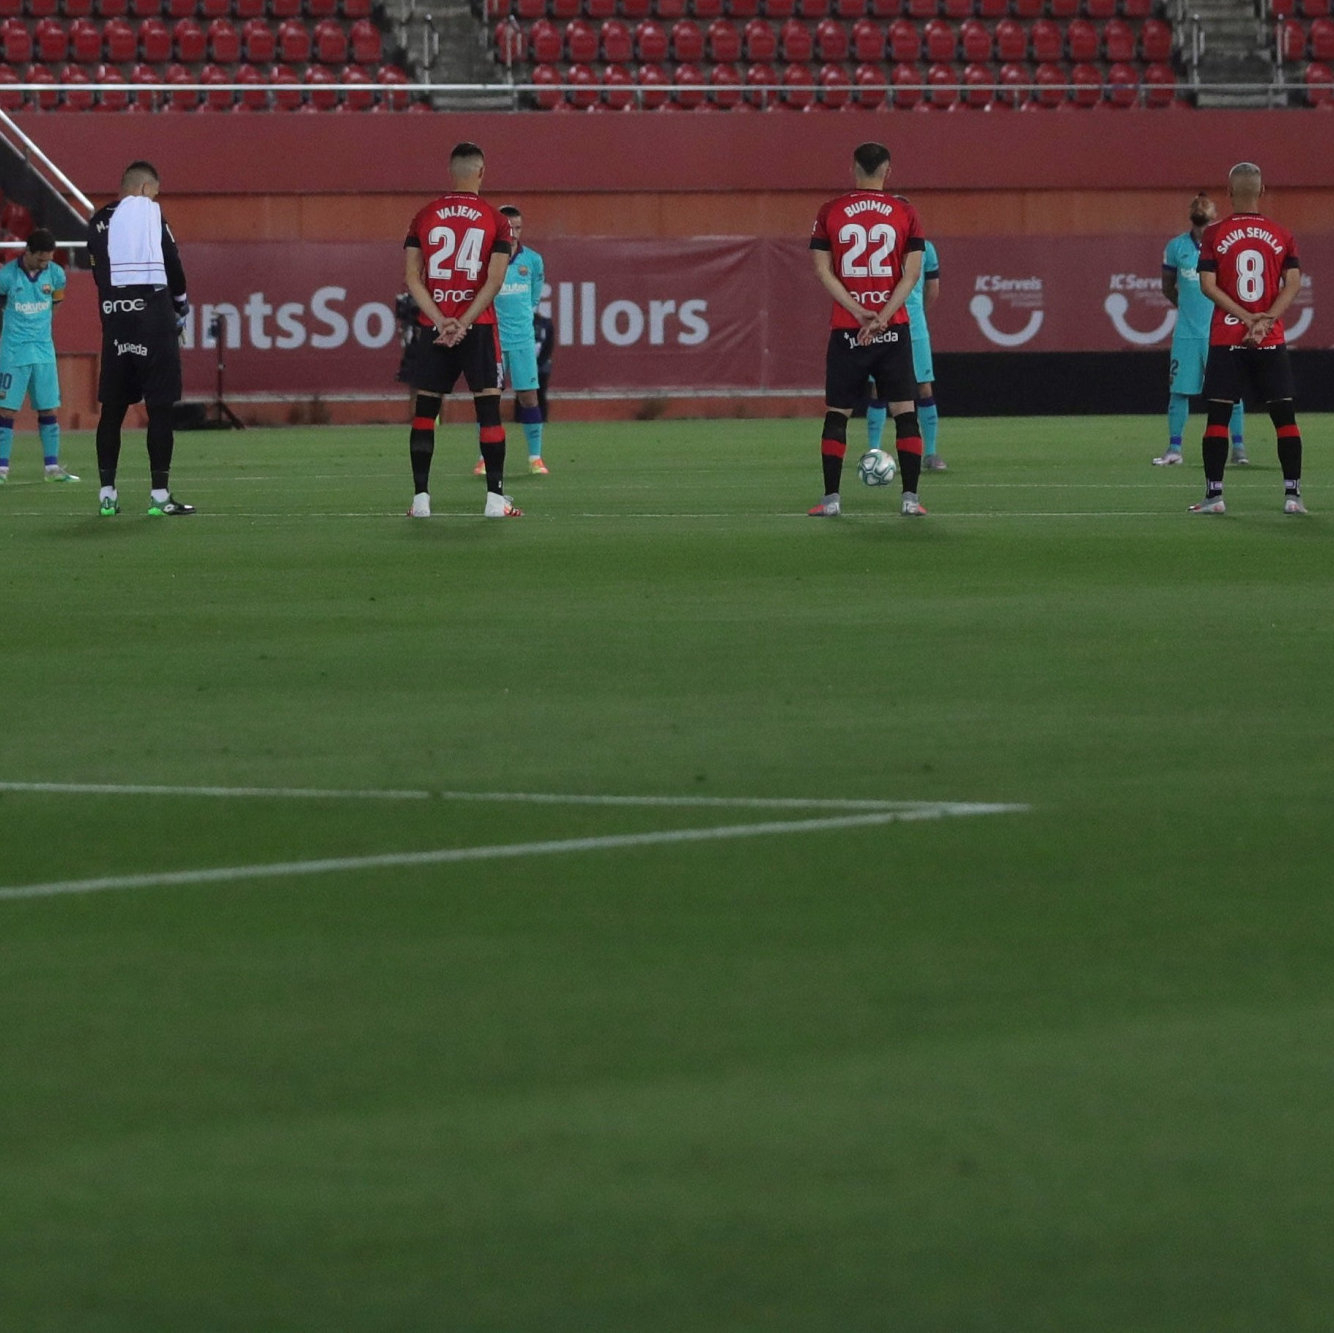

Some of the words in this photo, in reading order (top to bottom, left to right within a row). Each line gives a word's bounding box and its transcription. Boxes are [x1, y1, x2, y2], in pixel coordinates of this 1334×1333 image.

[436, 205, 482, 221] VALJENT
[844, 200, 893, 217] BUDIMIR
[429, 226, 485, 281] 24
[839, 223, 896, 277] 22
[1217, 229, 1245, 255] SALVA
[1247, 227, 1283, 255] SEVILLA
[1236, 249, 1264, 302] 8
